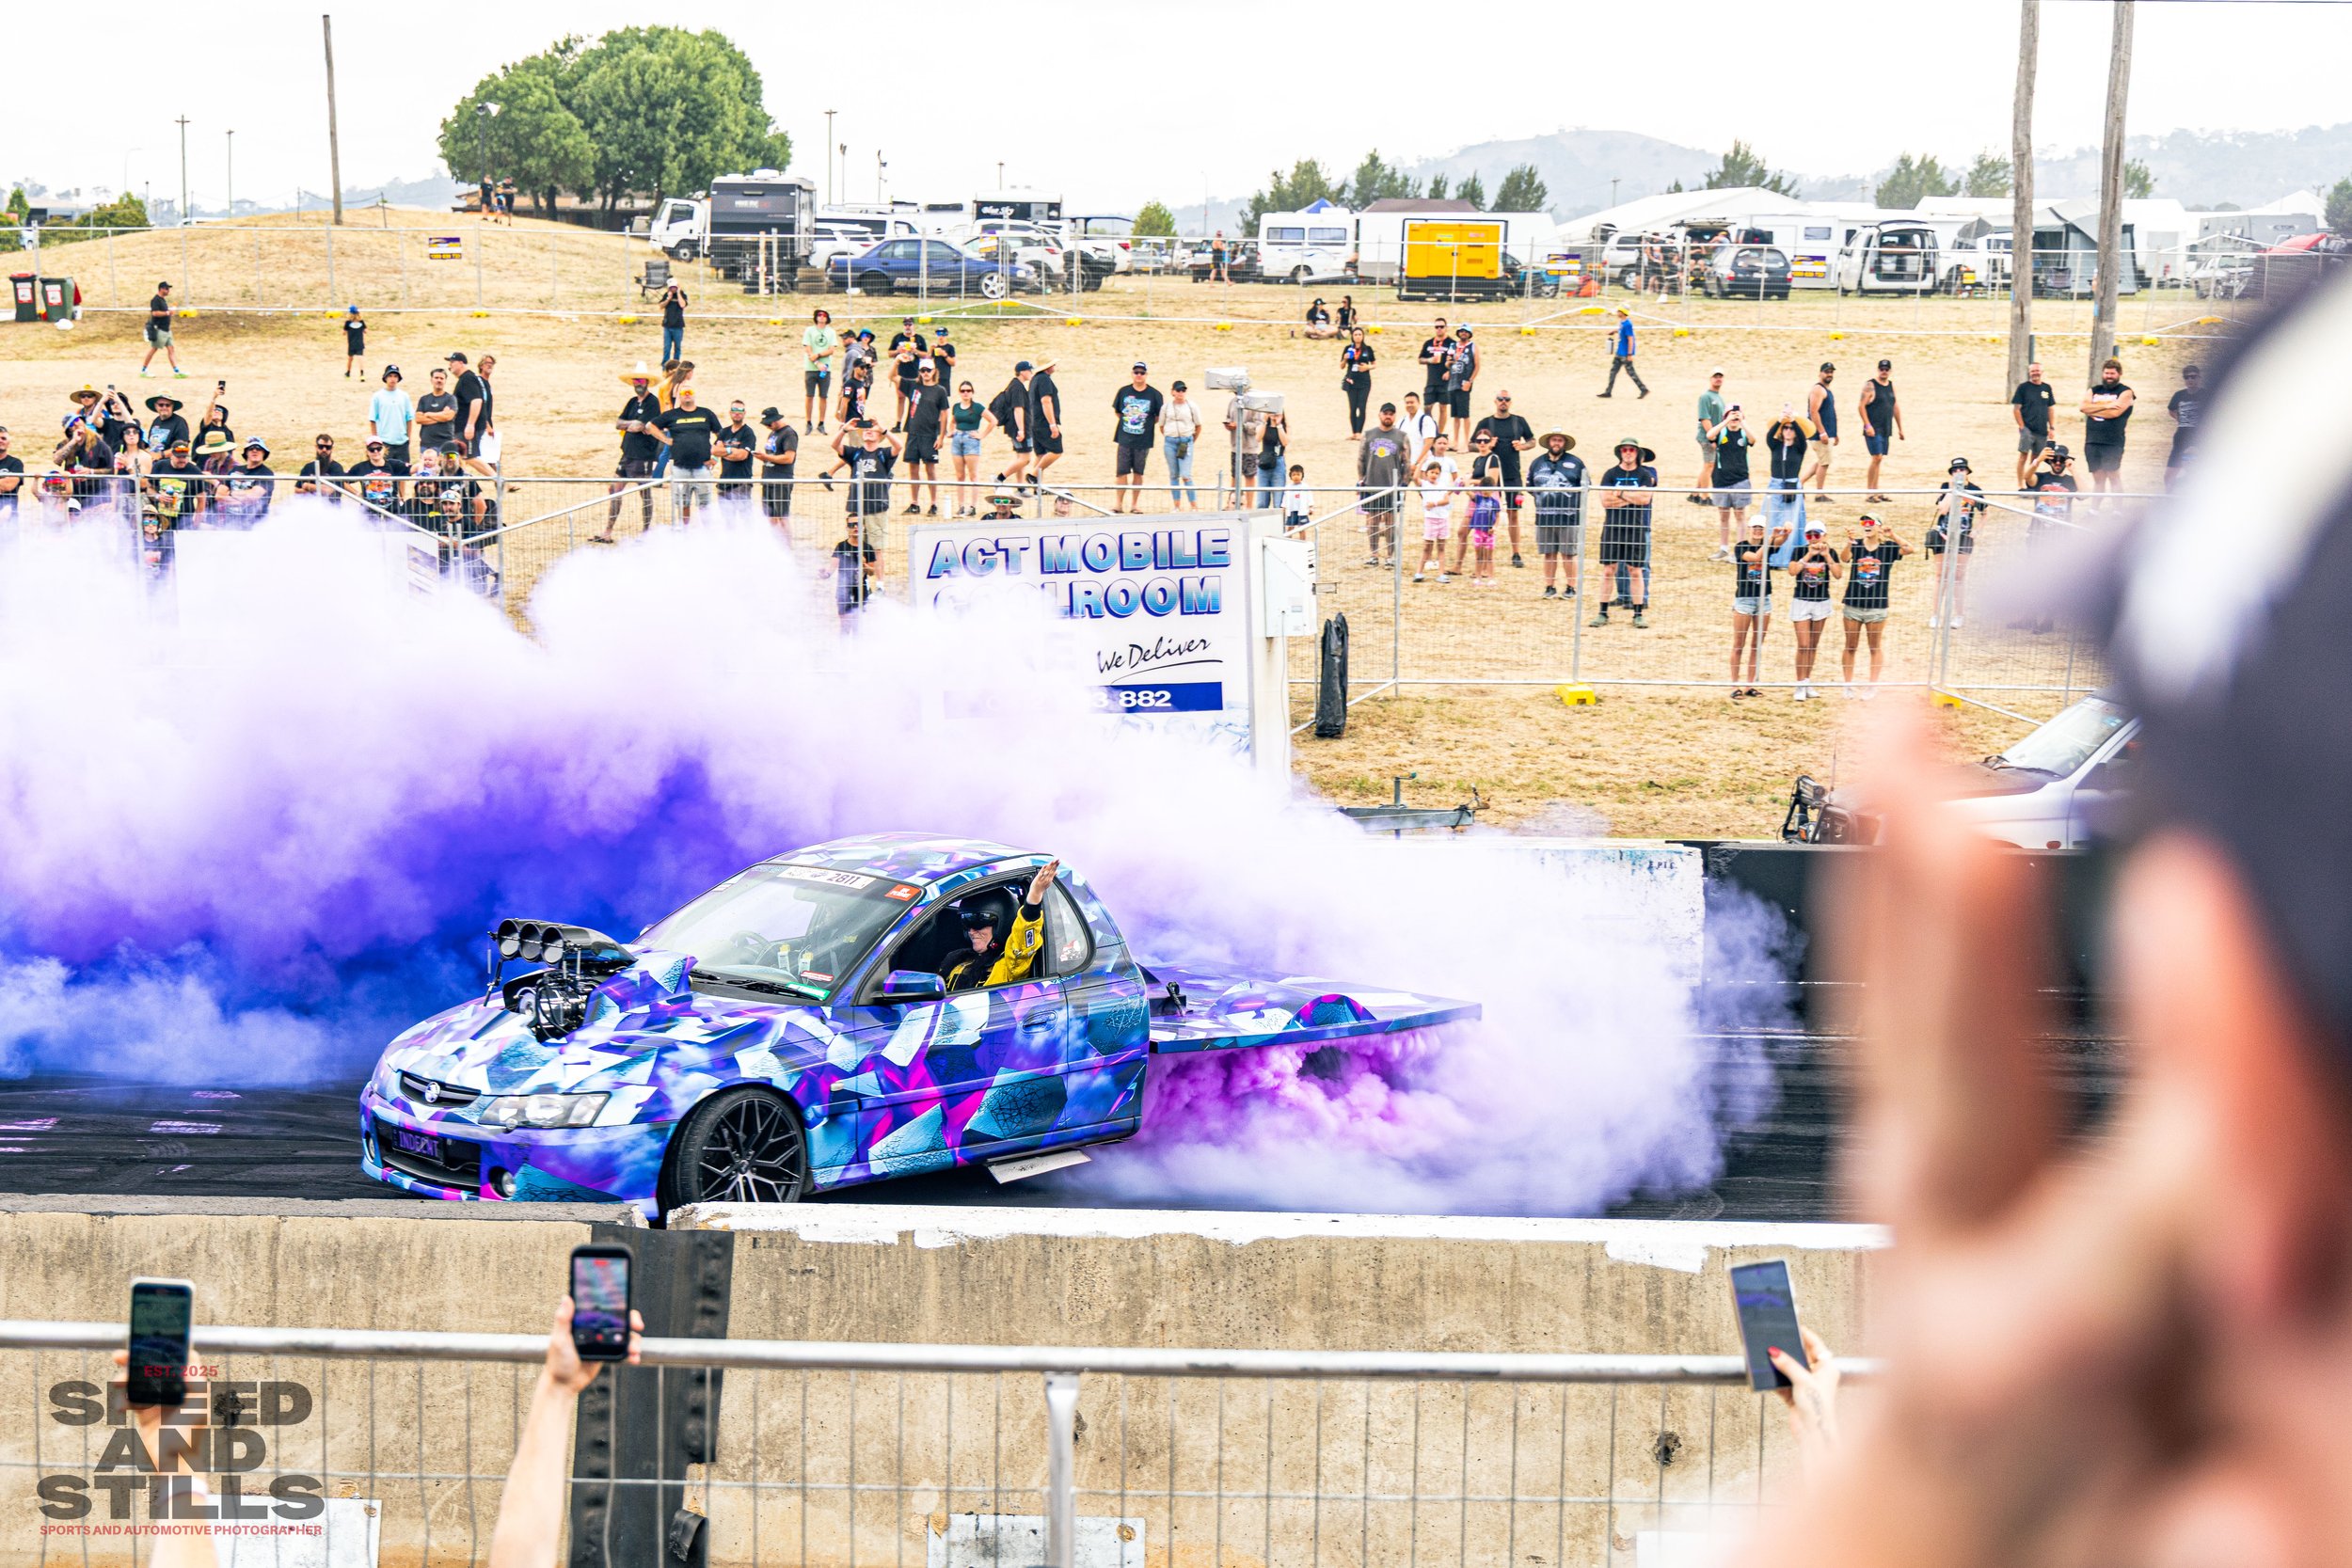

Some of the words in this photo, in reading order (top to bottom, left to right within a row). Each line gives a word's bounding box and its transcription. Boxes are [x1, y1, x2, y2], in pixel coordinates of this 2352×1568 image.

[927, 536, 1030, 579] ACT
[1040, 529, 1231, 576] MOBILE
[1097, 650, 1123, 674] We
[1127, 636, 1212, 670] Deliver
[1119, 689, 1172, 708] 882
[826, 873, 860, 886] 2811
